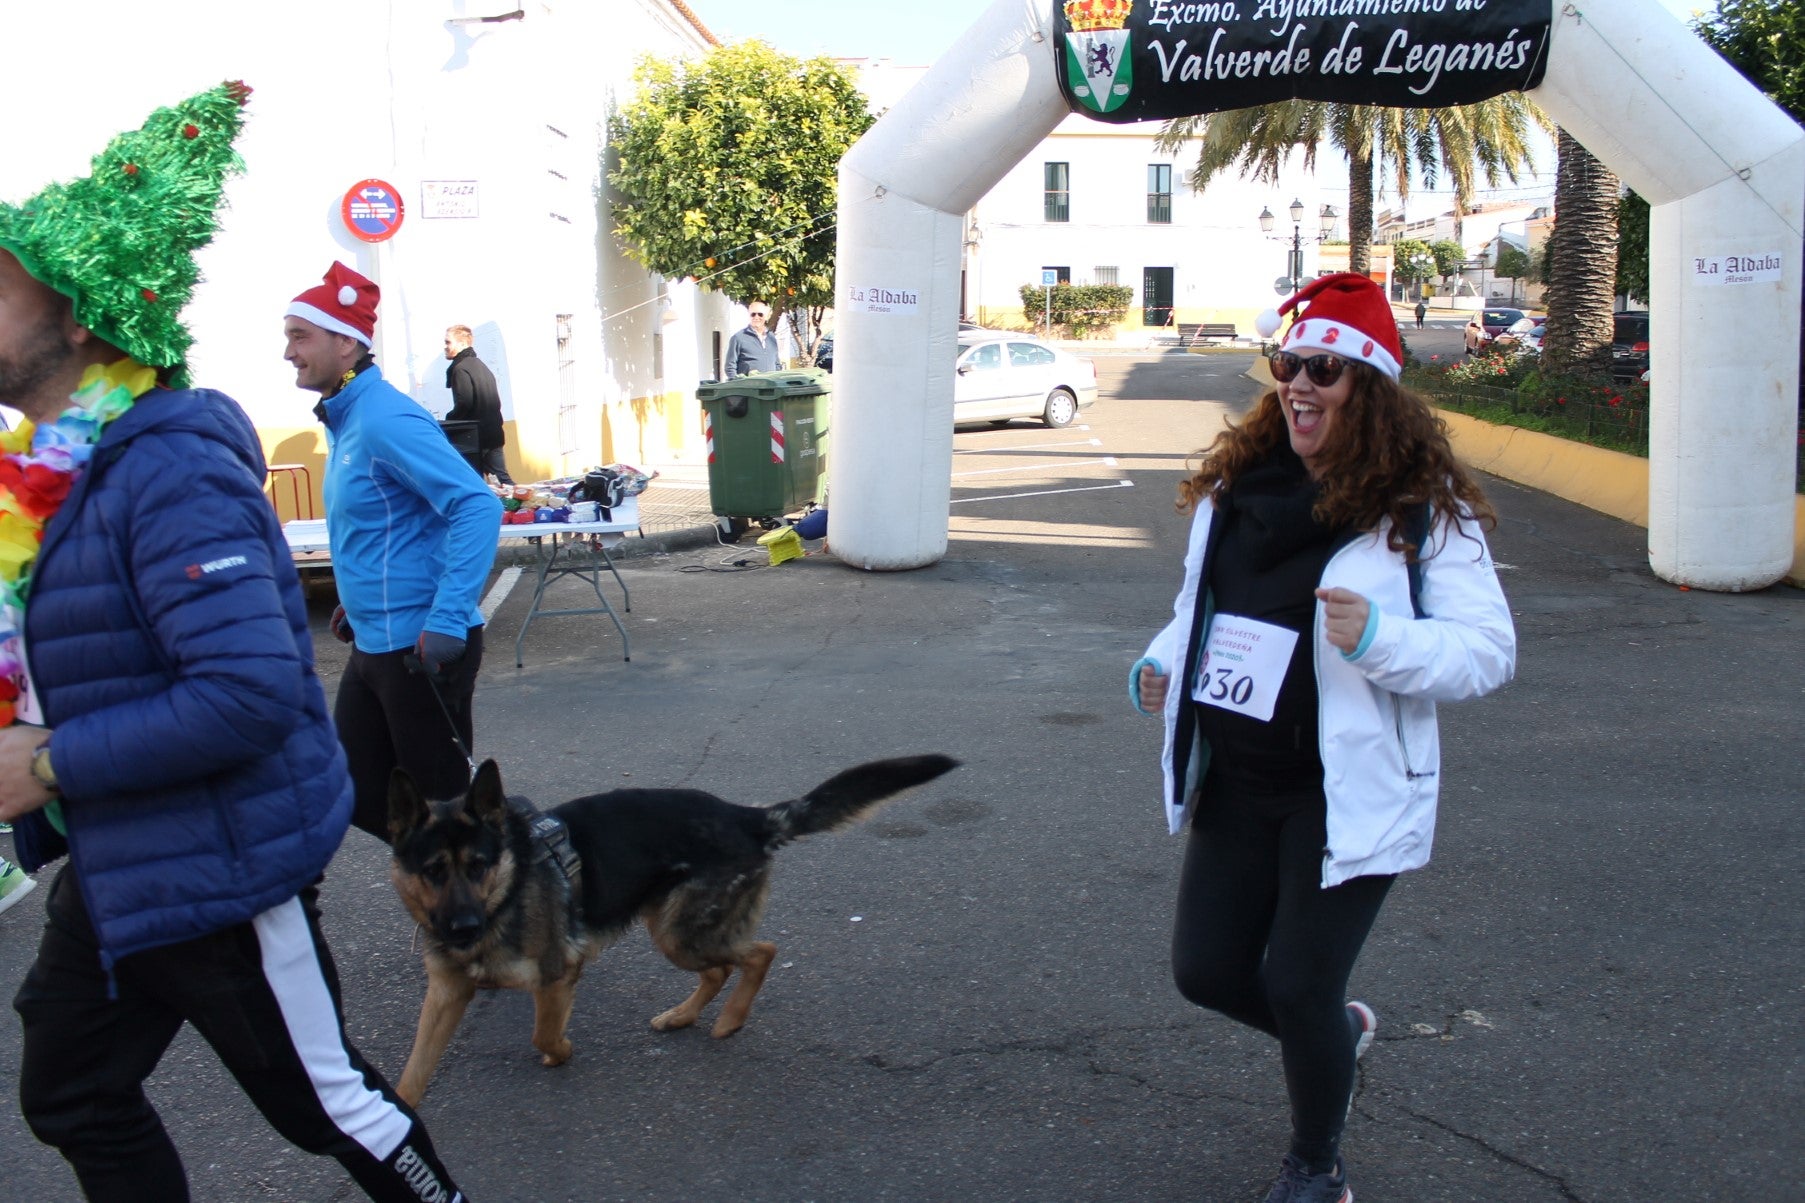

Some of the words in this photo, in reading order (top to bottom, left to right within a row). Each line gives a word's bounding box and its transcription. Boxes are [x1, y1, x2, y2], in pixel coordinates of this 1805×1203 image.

[1148, 0, 1240, 32] Excmo.
[1252, 0, 1446, 36] Ayuntamiento
[1455, 0, 1487, 12] de
[1148, 28, 1311, 83] Valverde
[1319, 21, 1363, 75] de
[1372, 28, 1532, 95] Leganés
[442, 185, 475, 196] PLAZA
[1694, 257, 1719, 275] La
[1725, 254, 1781, 273] Aldaba
[849, 285, 864, 302] La
[869, 287, 917, 305] Aldaba
[1225, 627, 1262, 643] SILVESTRE
